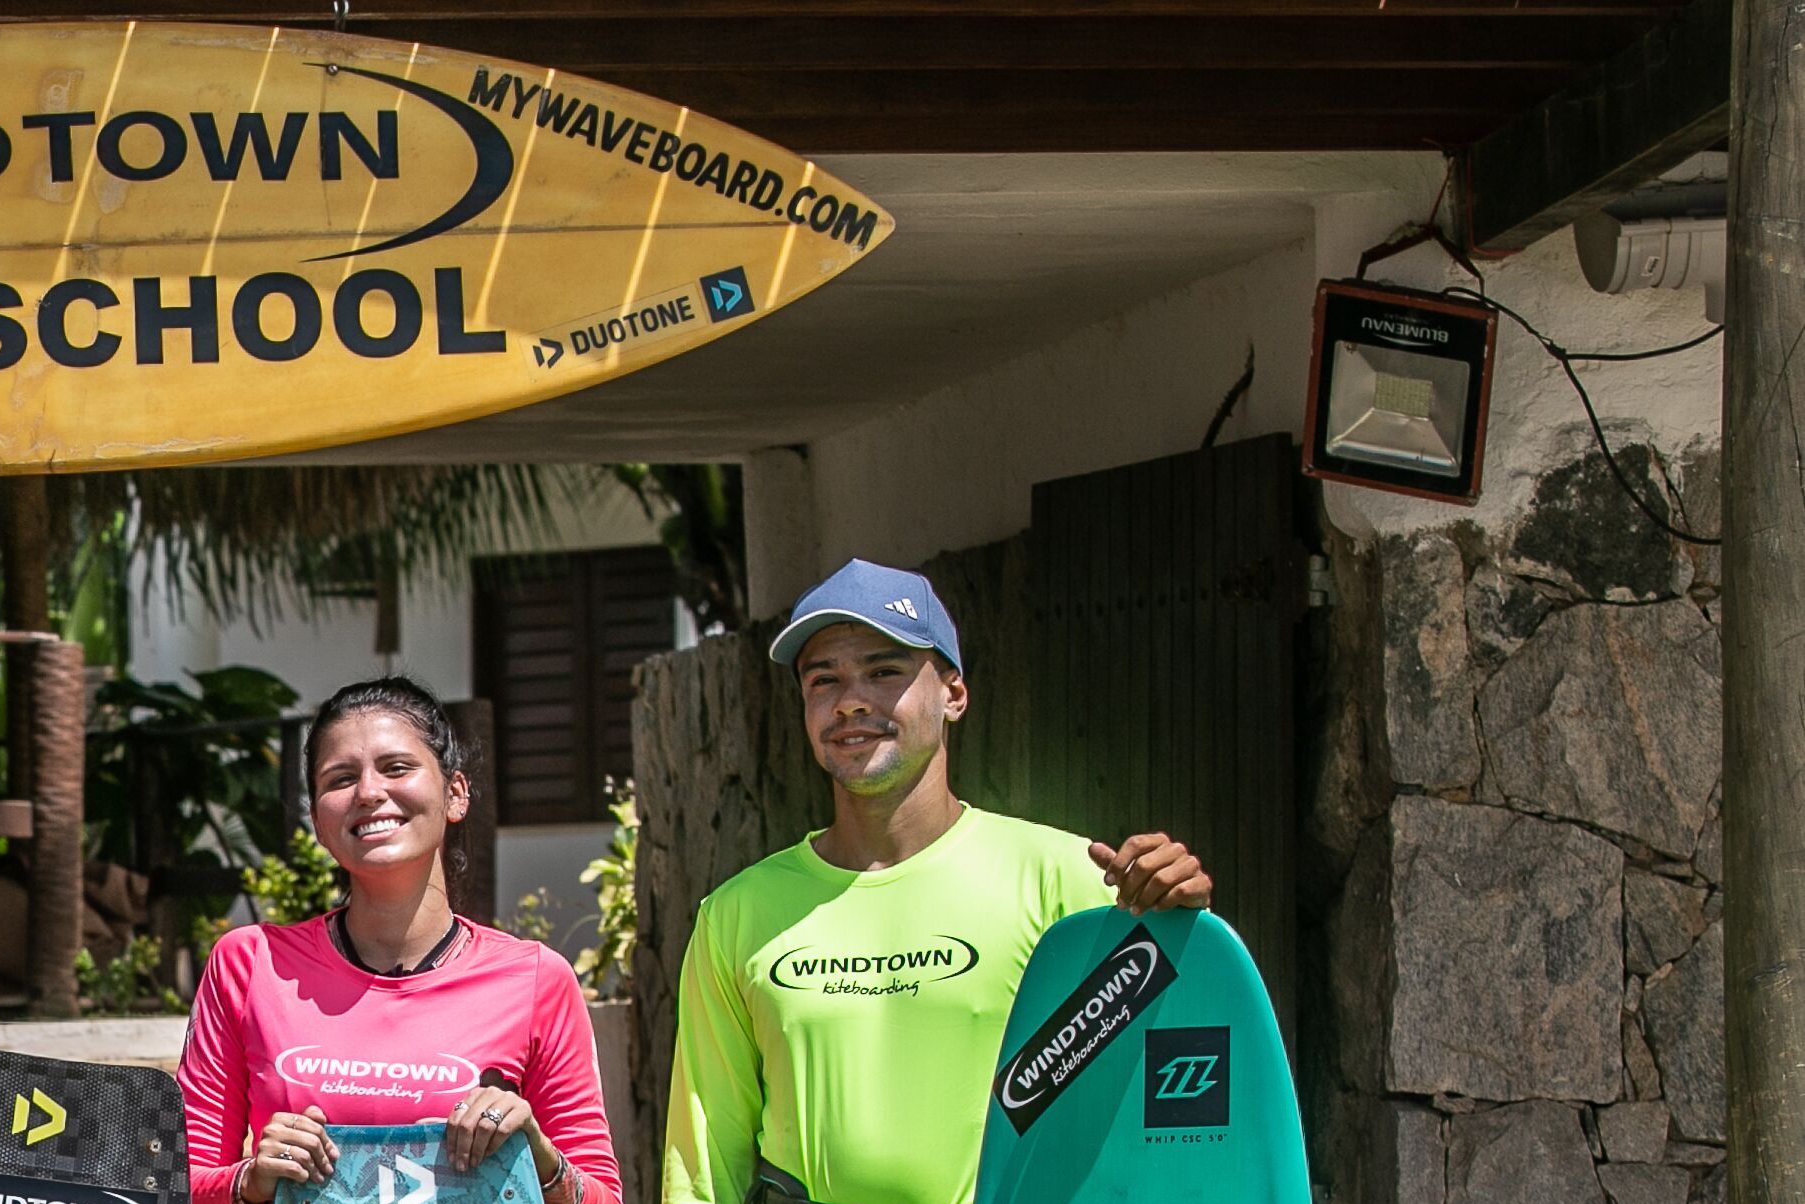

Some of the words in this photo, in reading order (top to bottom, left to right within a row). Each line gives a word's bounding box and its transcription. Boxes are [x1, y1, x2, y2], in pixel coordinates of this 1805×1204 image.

[468, 65, 878, 251] MYWAVEBOARD.COM
[571, 295, 696, 356] DUOTONE
[1360, 316, 1449, 343] BLUMENAU
[791, 949, 953, 977] WINDTOWN
[1016, 958, 1142, 1089] WINDTOWN
[295, 1056, 459, 1083] WINDTOWN
[1182, 1134, 1202, 1144] CSC
